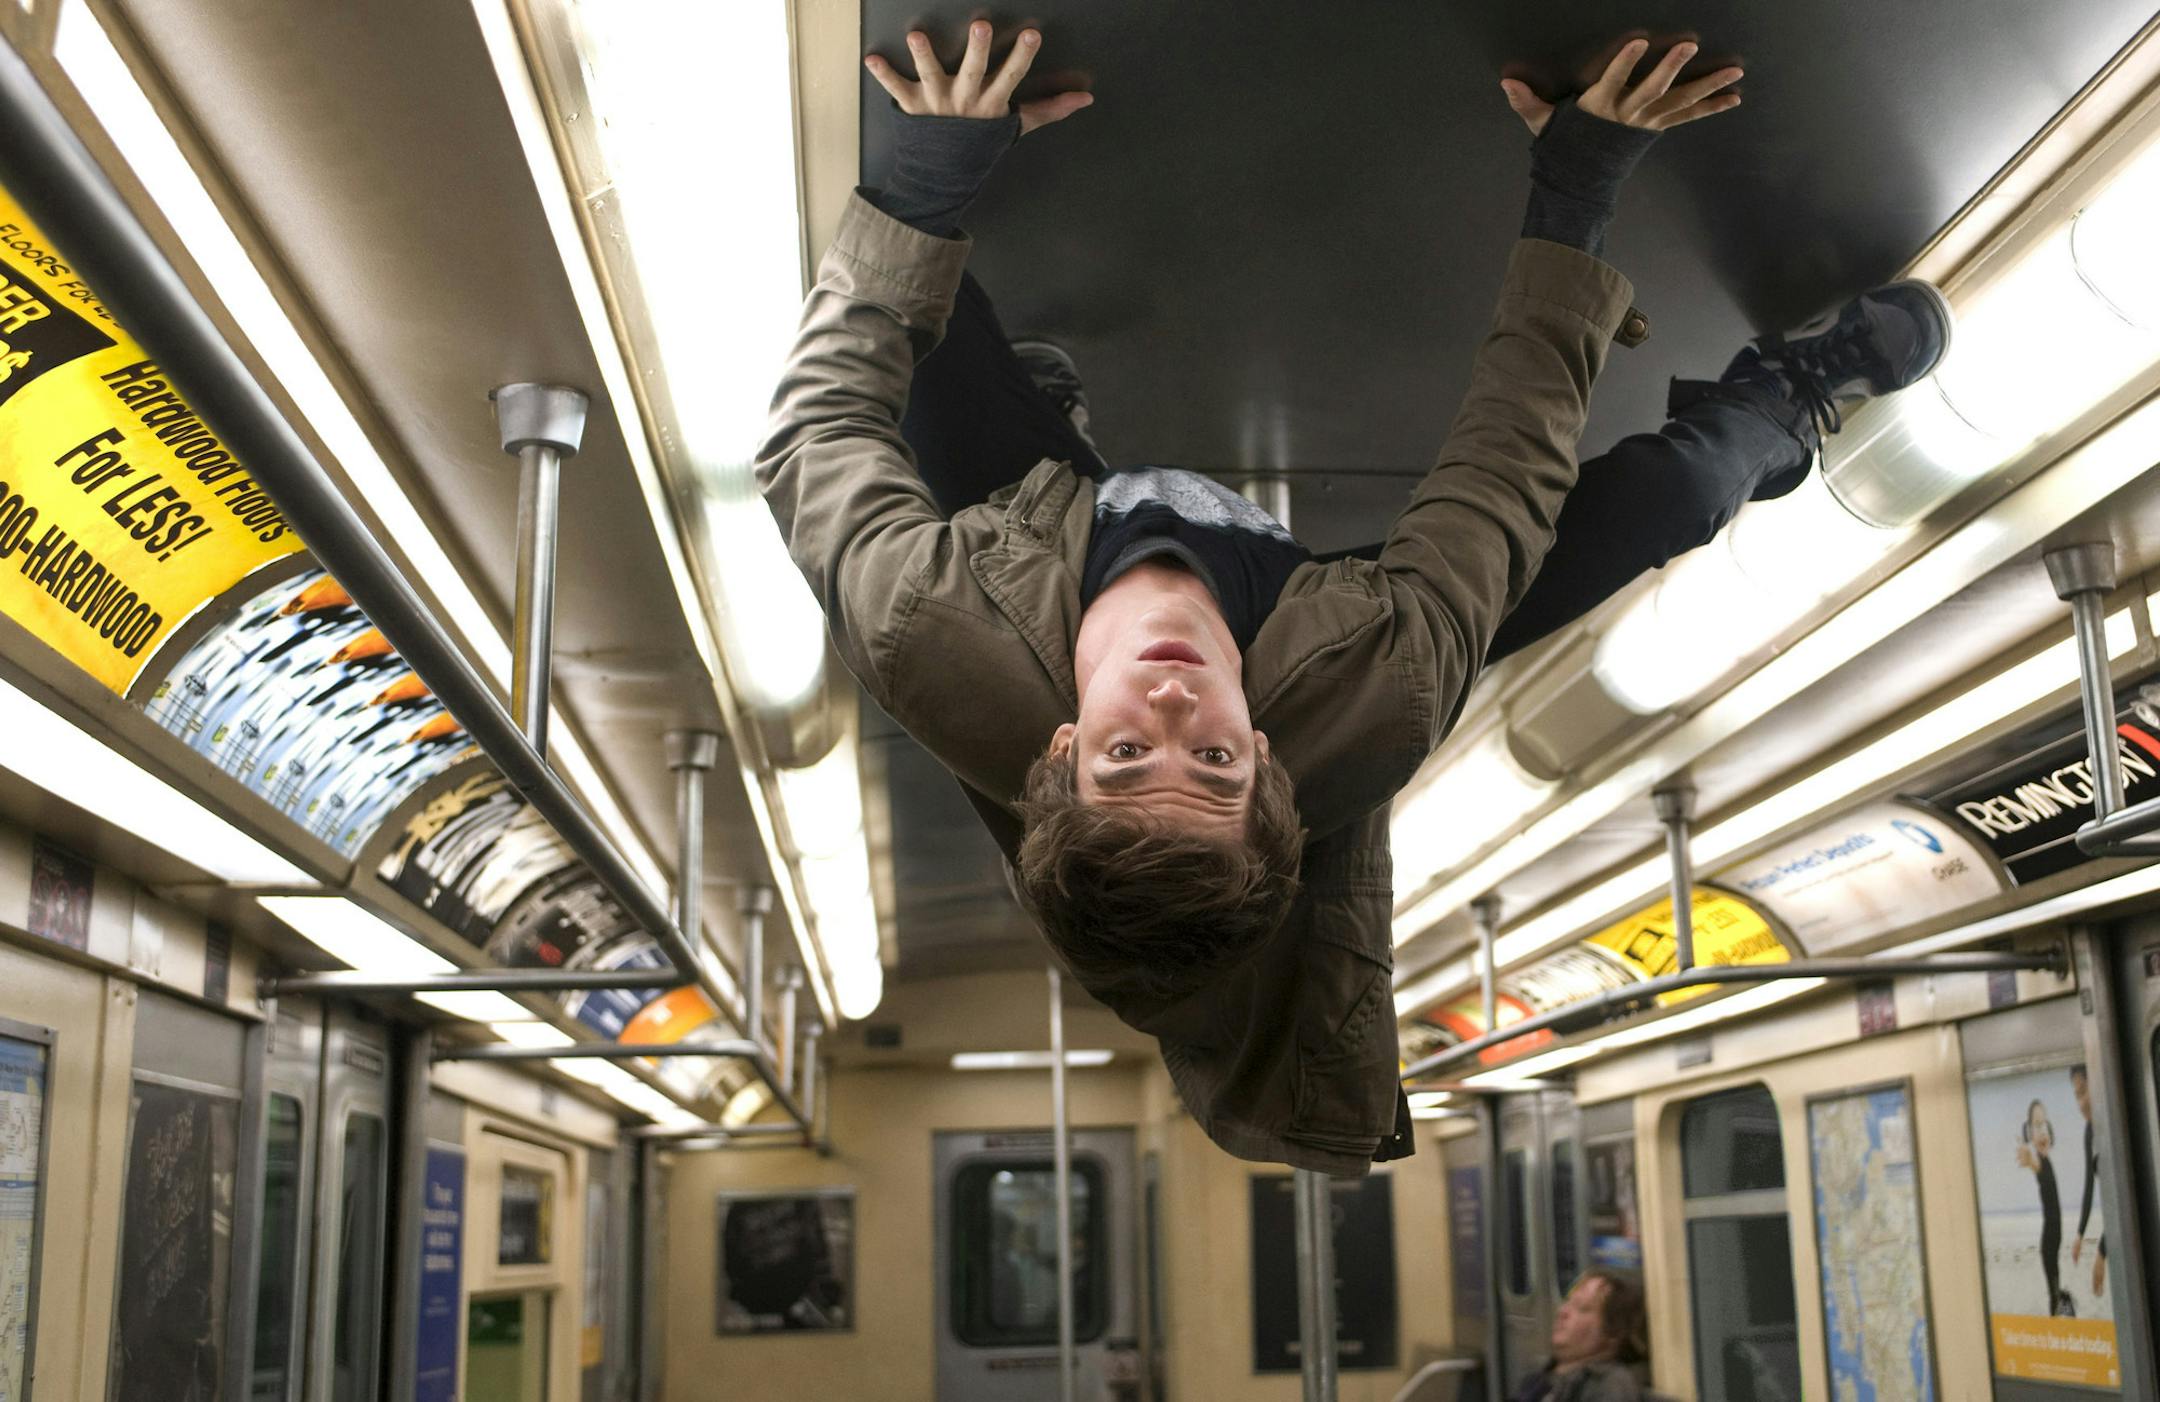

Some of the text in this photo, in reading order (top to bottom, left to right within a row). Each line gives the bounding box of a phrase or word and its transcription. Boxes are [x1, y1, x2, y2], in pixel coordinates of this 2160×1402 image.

[0, 223, 71, 278] FLOORS
[0, 273, 51, 334] ER
[54, 427, 214, 562] For LESS!
[100, 359, 293, 543] Hardwood Floors
[0, 481, 163, 658] 00-HARDWOOD
